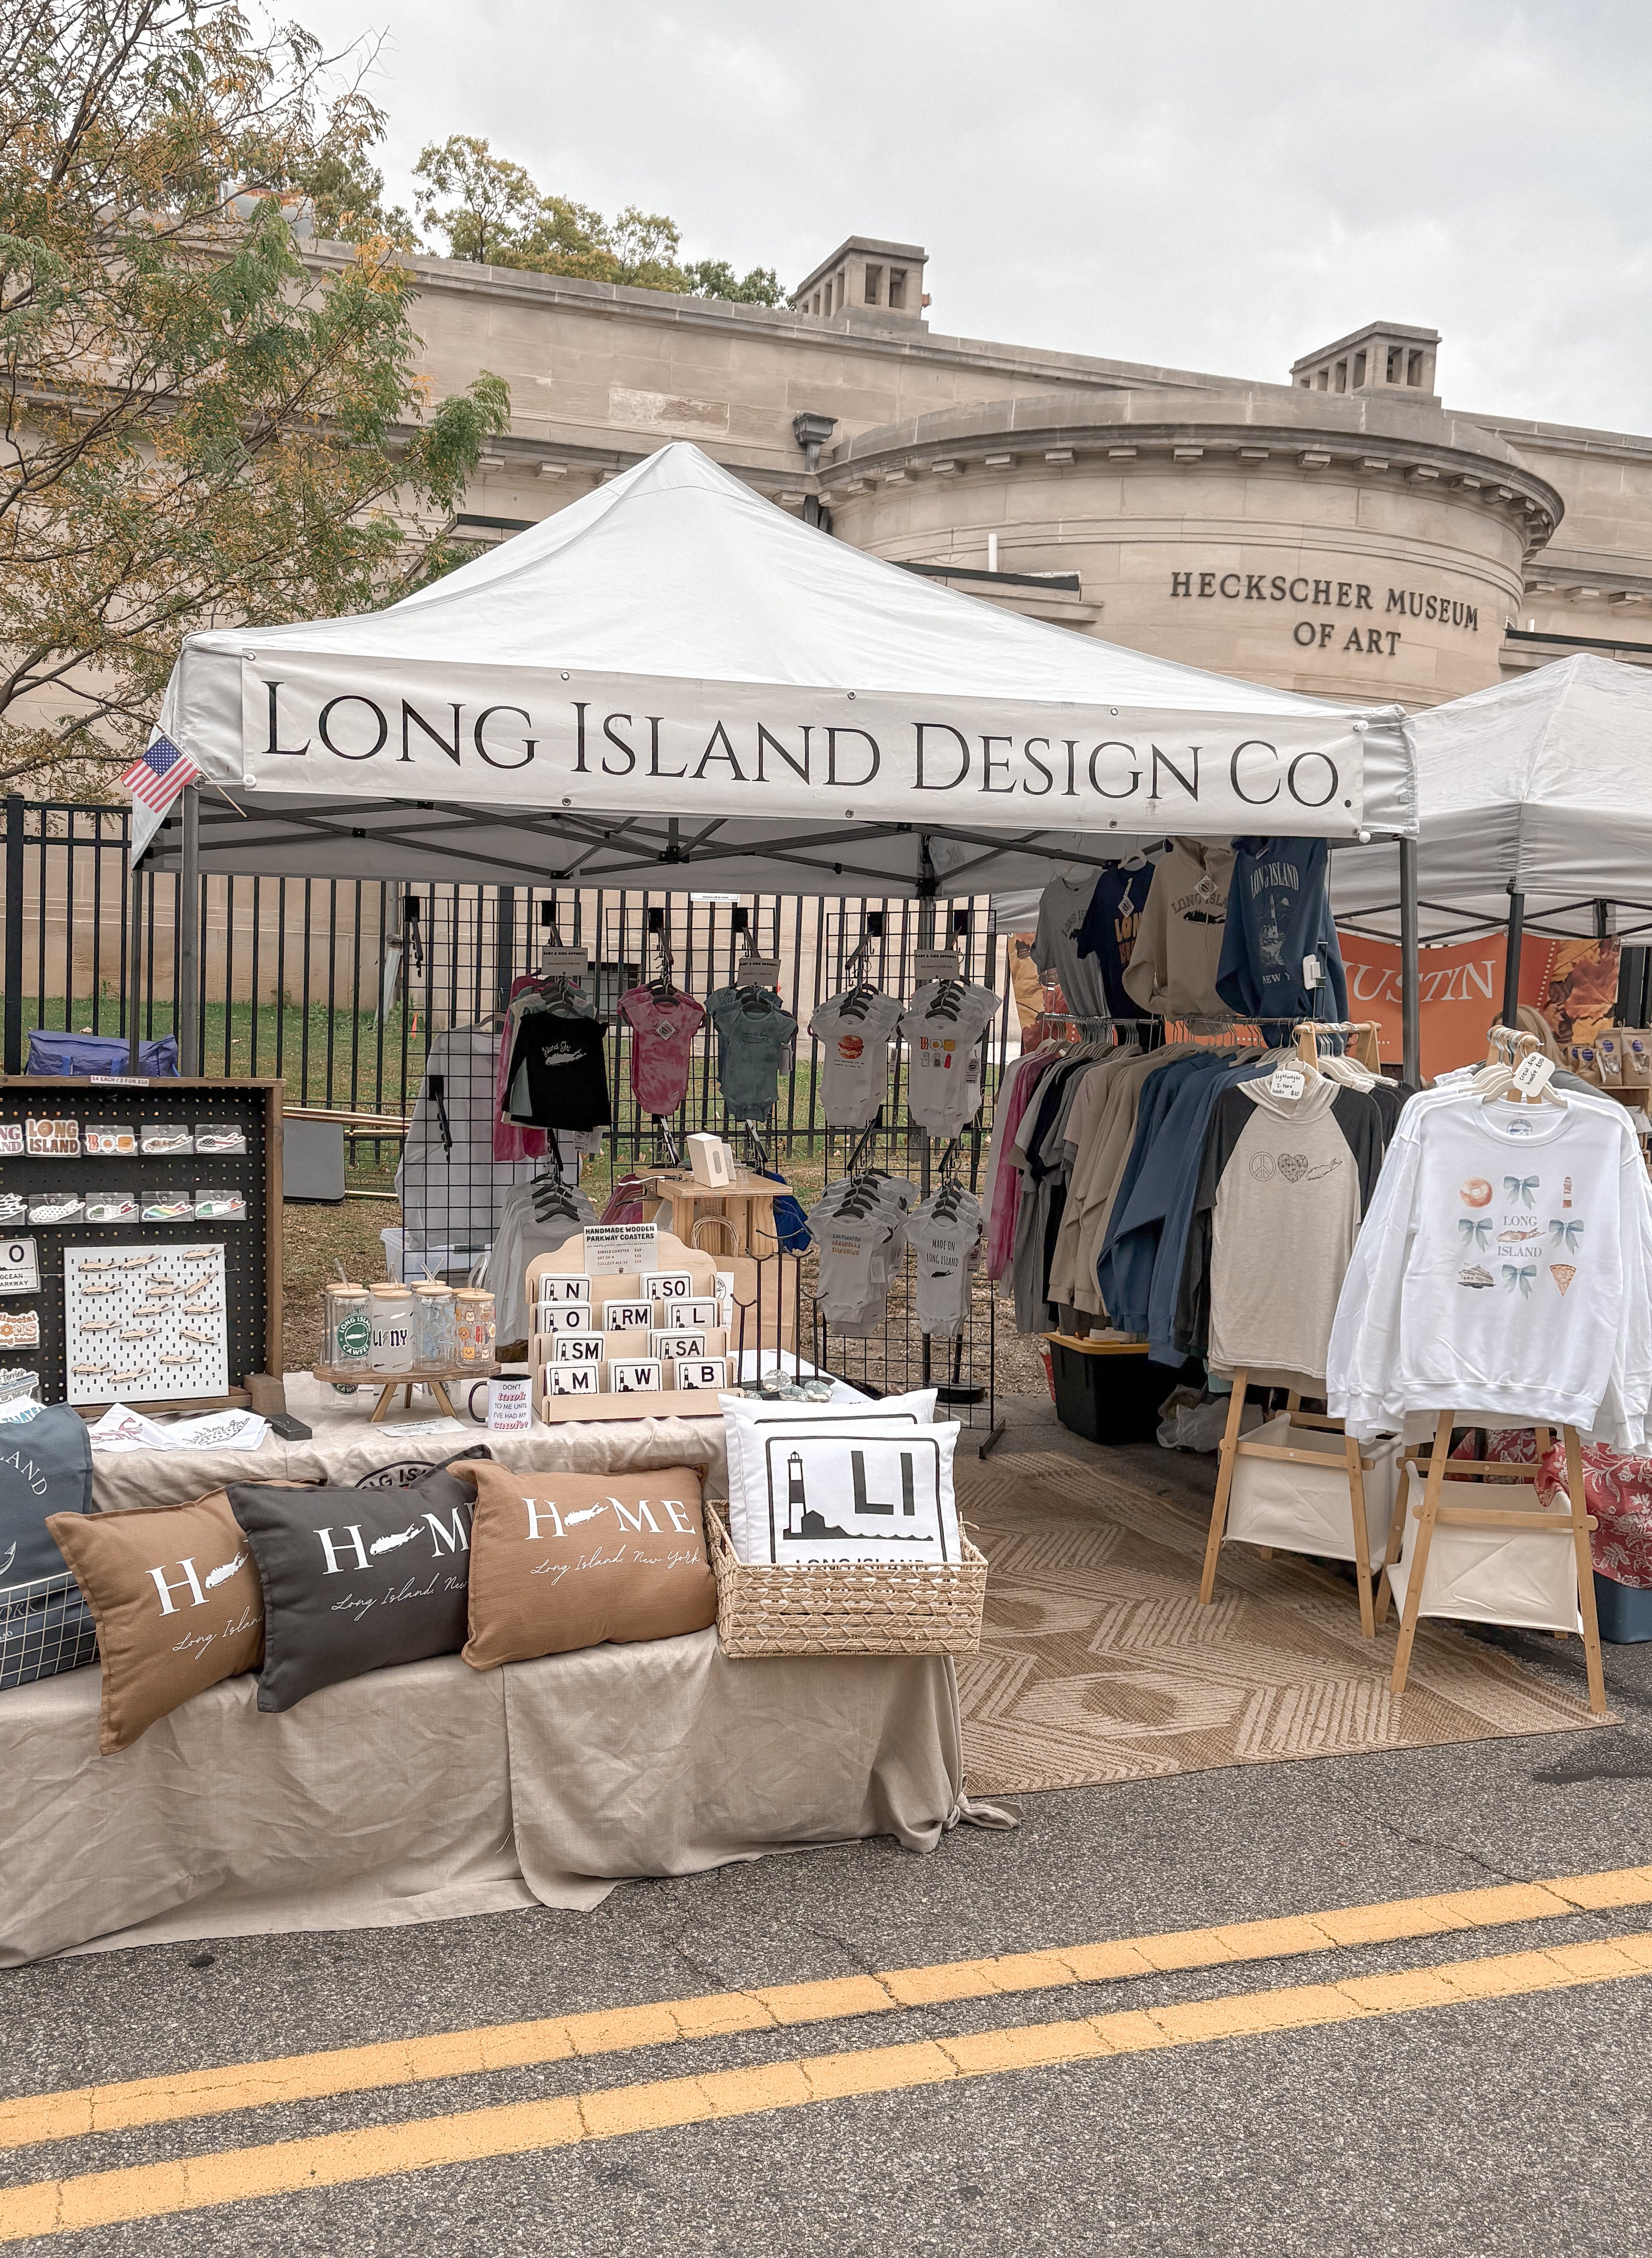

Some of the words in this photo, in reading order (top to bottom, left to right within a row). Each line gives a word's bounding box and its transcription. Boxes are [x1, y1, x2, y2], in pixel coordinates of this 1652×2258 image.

[1170, 571, 1373, 610] HECKSCHER
[1385, 588, 1478, 631] MUSEUM
[1293, 621, 1334, 647] OF
[1343, 627, 1401, 655] ART
[29, 1120, 77, 1138] LONG
[30, 1138, 78, 1153] ISLAND
[1503, 1216, 1538, 1226] LONG
[9, 1244, 24, 1262] O
[932, 1239, 946, 1250] MADE
[947, 1241, 955, 1251] ON
[1497, 1246, 1542, 1257] ISLAND
[926, 1253, 939, 1264] LONG
[941, 1255, 959, 1267] ISLAND
[566, 1283, 580, 1299] N
[662, 1280, 685, 1296] SO
[566, 1311, 580, 1327] O
[622, 1308, 649, 1325] RM
[693, 1308, 706, 1324] L
[339, 1317, 356, 1334] LONG
[572, 1342, 599, 1360] SM
[675, 1340, 701, 1356] SA
[572, 1372, 589, 1390] M
[634, 1368, 652, 1385] W
[701, 1366, 715, 1382] B
[497, 1391, 526, 1401] tawk
[493, 1420, 529, 1430] cawfee
[0, 1450, 47, 1495] AND
[850, 1450, 915, 1516] LI
[530, 1559, 570, 1586] Long
[633, 1551, 662, 1564] New
[667, 1546, 701, 1569] York
[331, 1593, 377, 1621] Long
[172, 1632, 217, 1660] Long
